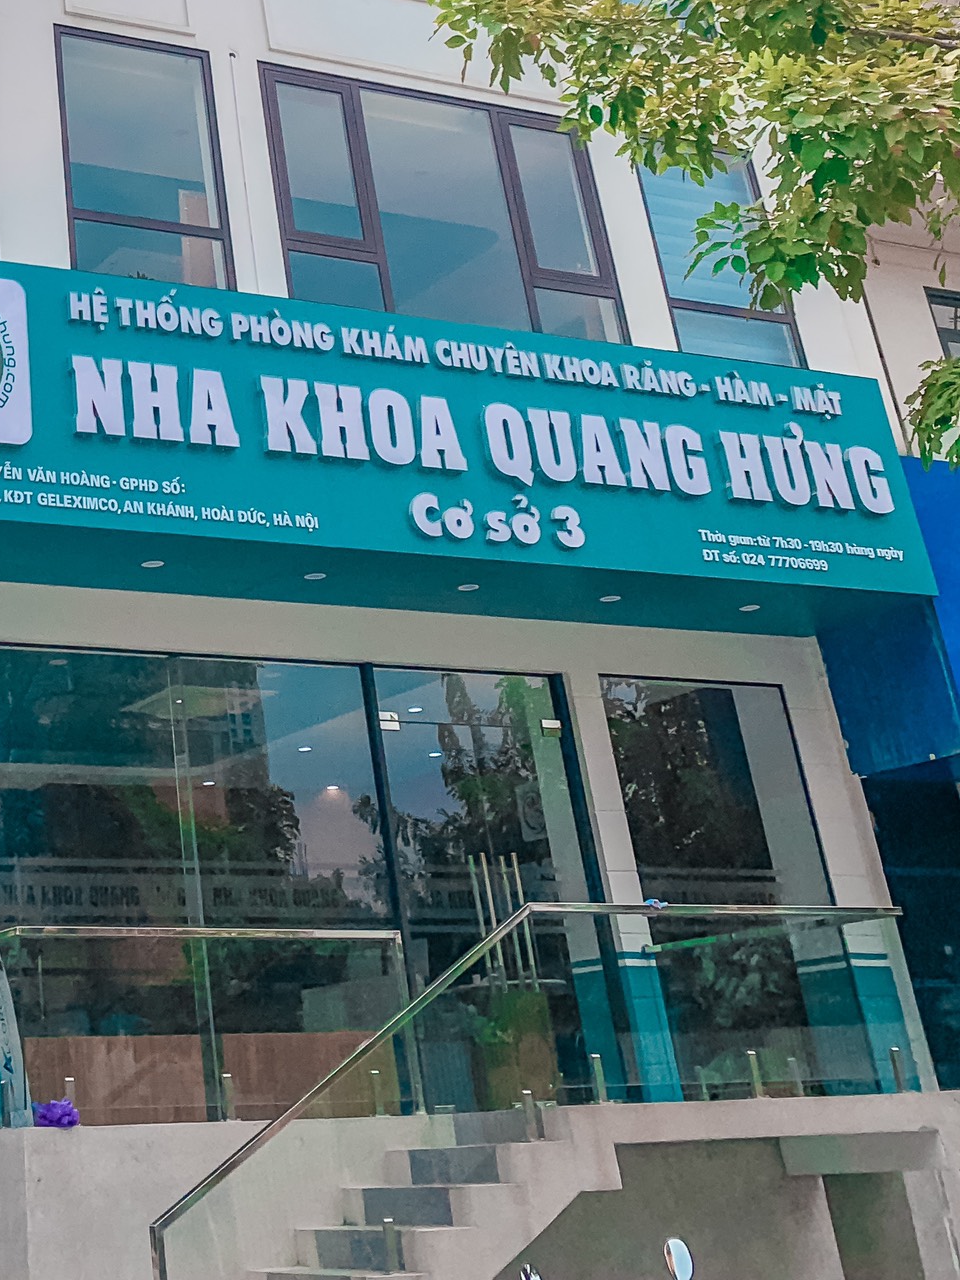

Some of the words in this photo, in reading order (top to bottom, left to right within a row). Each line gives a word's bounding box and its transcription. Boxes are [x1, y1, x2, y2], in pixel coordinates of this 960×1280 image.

[67, 286, 108, 333] HỆ
[114, 288, 223, 337] THỐNG
[231, 309, 334, 352] PHÒNG
[341, 324, 430, 365] KHÁM
[435, 338, 540, 378] CHUYÊN
[543, 352, 620, 389] KHOA
[623, 358, 697, 398] RĂNG
[714, 371, 776, 409] HÀM
[790, 383, 842, 420] MẶT
[71, 355, 240, 449] NHA
[259, 374, 468, 473] KHOA
[481, 402, 712, 496] QUANG
[719, 421, 896, 514] HƯNG
[27, 466, 56, 483] VĂN
[60, 470, 111, 488] HOÀNG
[119, 476, 159, 492] GPHĐ
[162, 476, 186, 494] SỐ:
[4, 489, 33, 505] KĐT
[37, 493, 122, 515] GELEXIMCO,
[123, 500, 144, 514] AN
[147, 501, 198, 521] KHÁNH,
[201, 505, 234, 522] HOÀI
[237, 507, 270, 528] ĐỨC,
[273, 511, 293, 527] HÀ
[295, 512, 319, 532] NỘI
[410, 491, 474, 539] Cơ
[484, 493, 541, 544] sở
[551, 505, 585, 548] 3
[697, 529, 726, 545] Thời
[772, 536, 802, 551] 7h30
[742, 553, 765, 566] 024
[768, 555, 828, 571] 77706699
